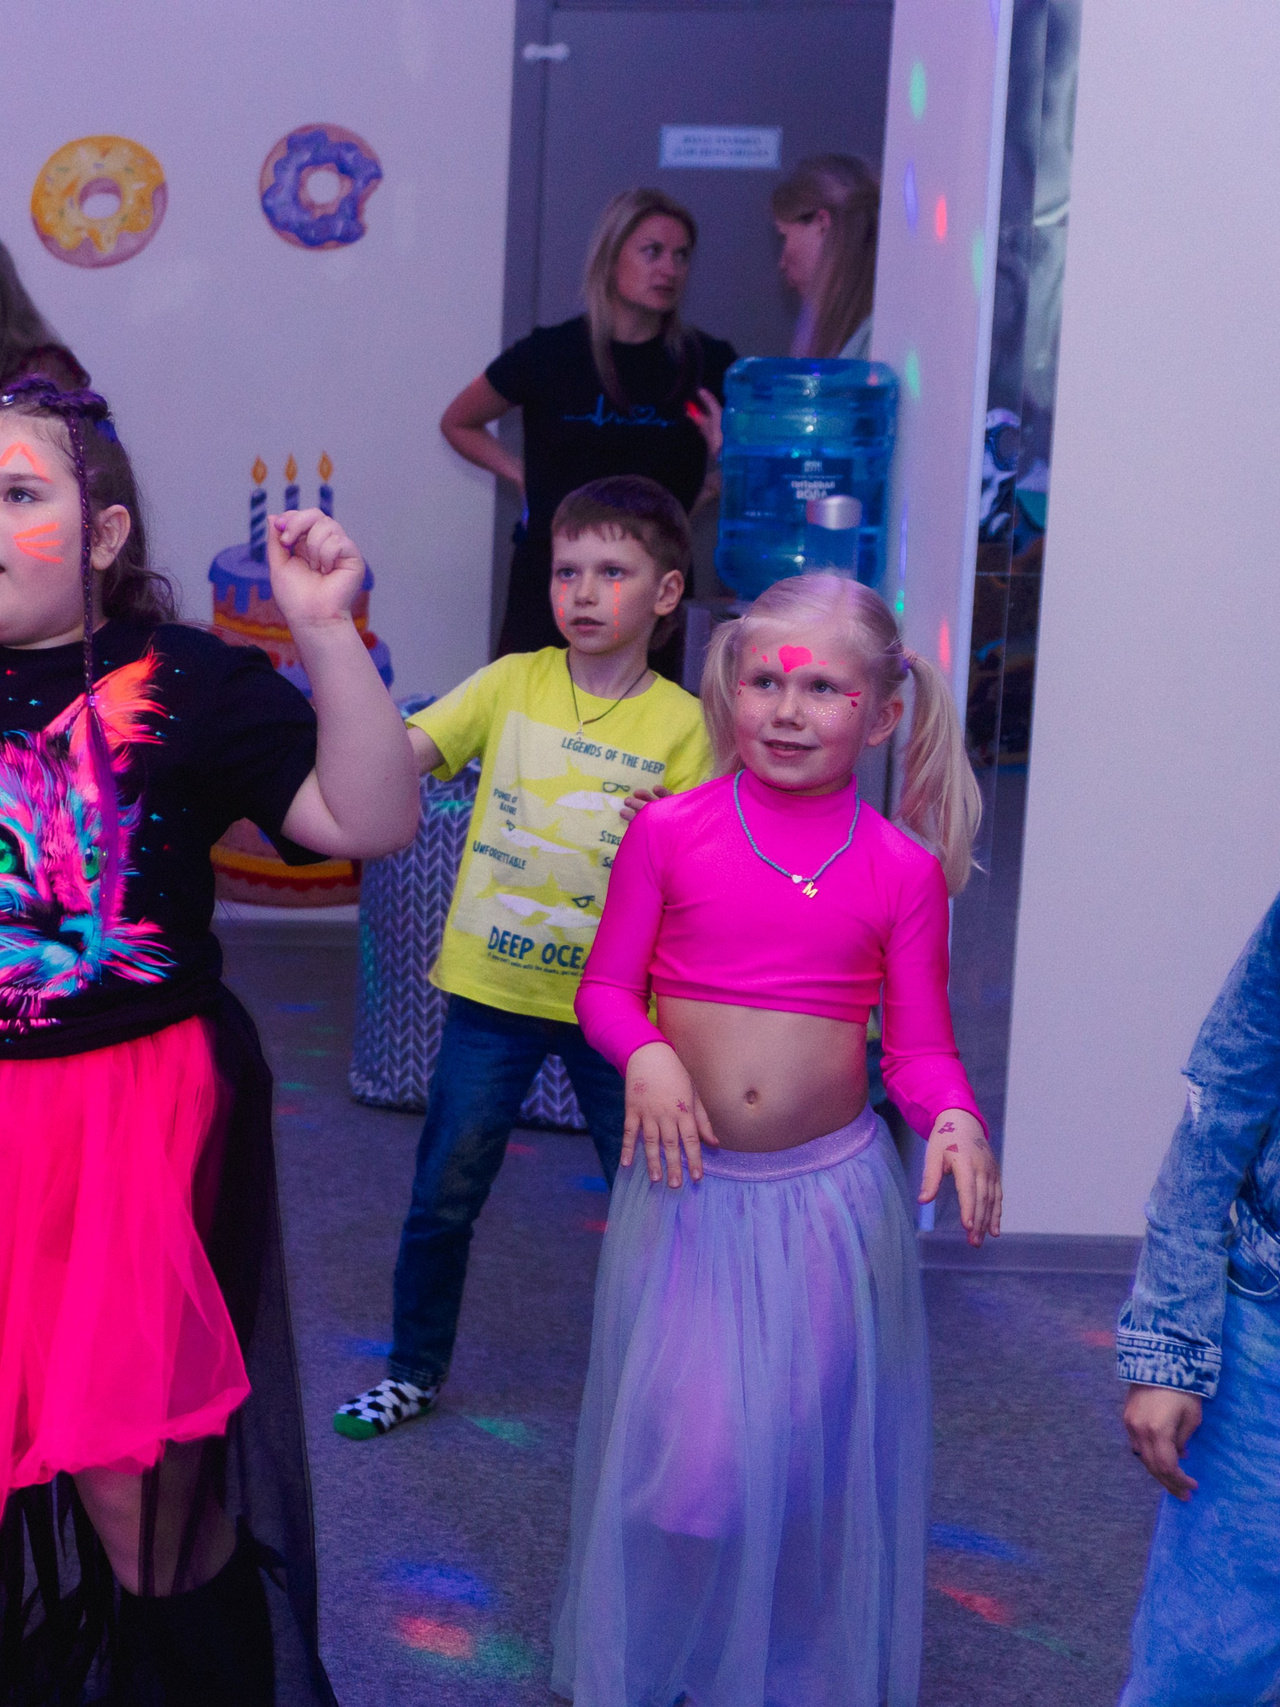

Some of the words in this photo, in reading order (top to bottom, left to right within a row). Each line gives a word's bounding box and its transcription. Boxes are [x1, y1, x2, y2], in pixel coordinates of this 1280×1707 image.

[561, 737, 603, 757] LEGENDS
[605, 749, 619, 761] OF
[621, 753, 640, 768] THE
[641, 759, 666, 775] DEEP
[599, 830, 622, 845] STRE
[472, 840, 527, 870] UNFORGETTABLE
[802, 881, 819, 898] M
[487, 925, 535, 960] DEEP
[541, 942, 588, 970] OCE
